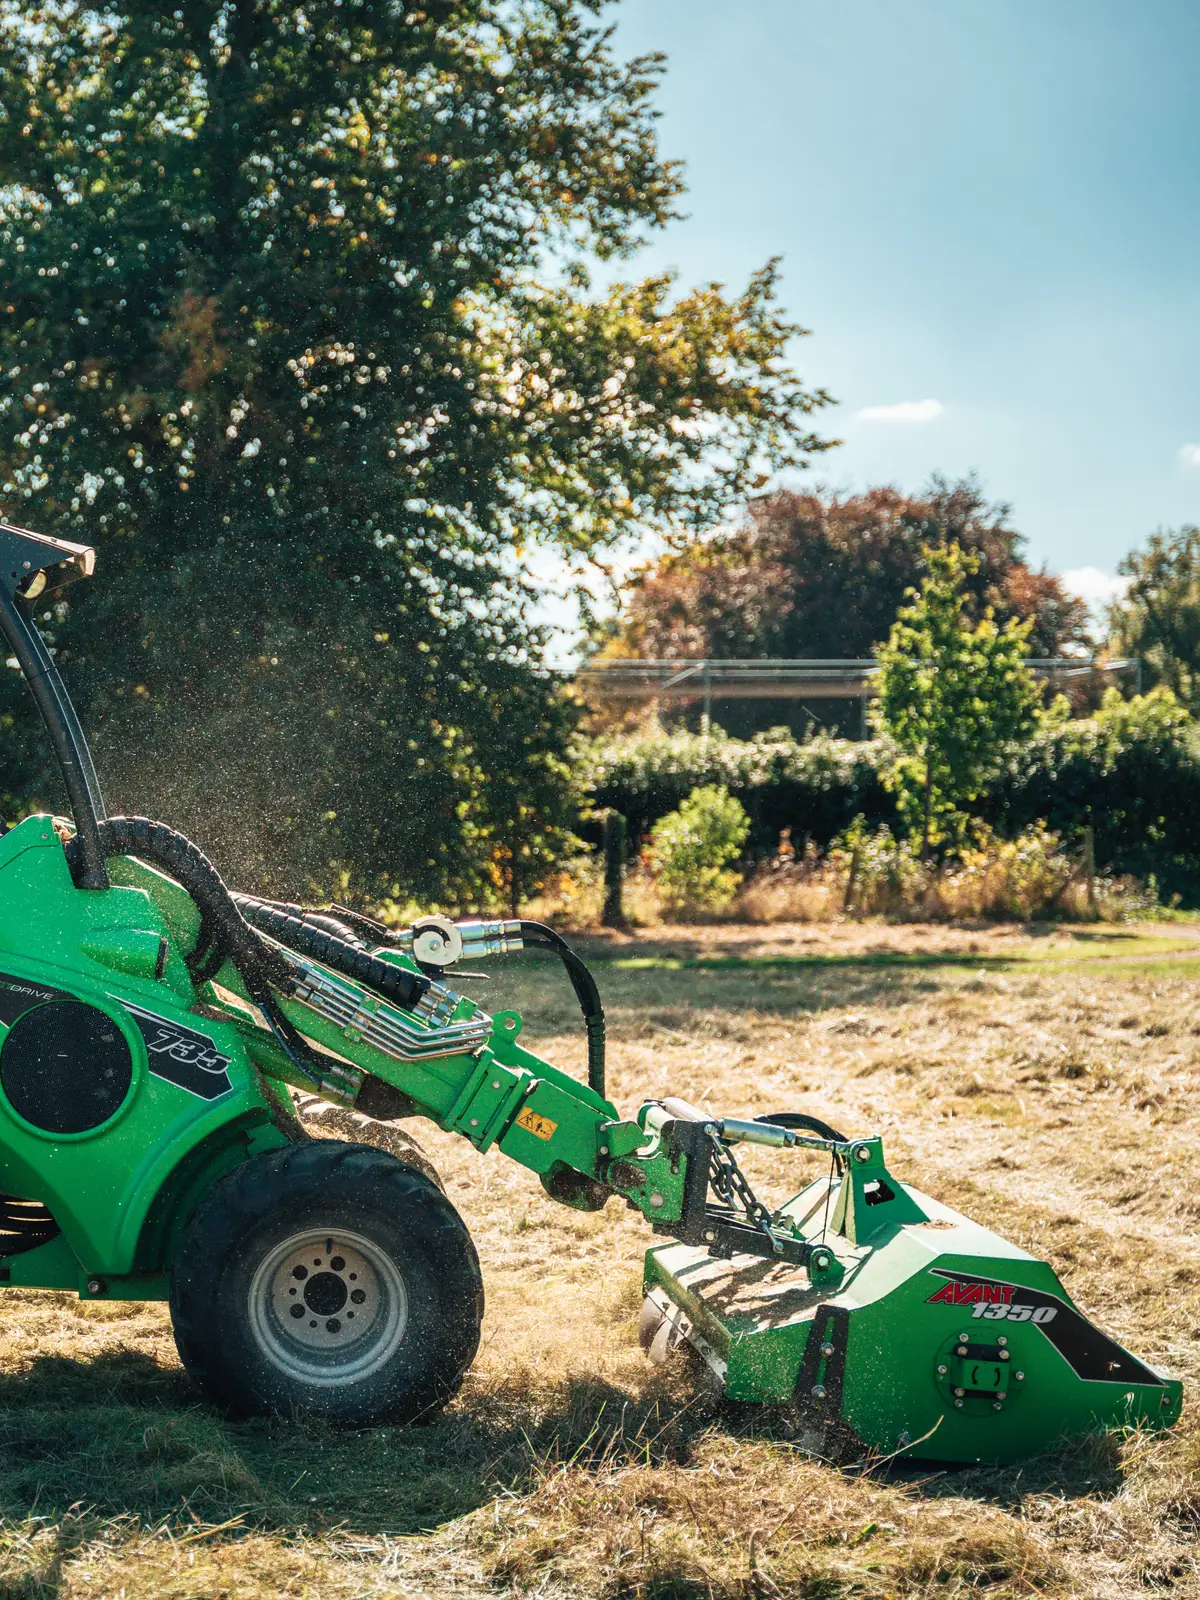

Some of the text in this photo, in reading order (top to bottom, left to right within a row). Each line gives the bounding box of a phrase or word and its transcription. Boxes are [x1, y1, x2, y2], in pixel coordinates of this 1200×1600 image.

[147, 1028, 233, 1075] 735
[925, 1281, 1016, 1305] AVANT
[971, 1302, 1058, 1323] 1350
